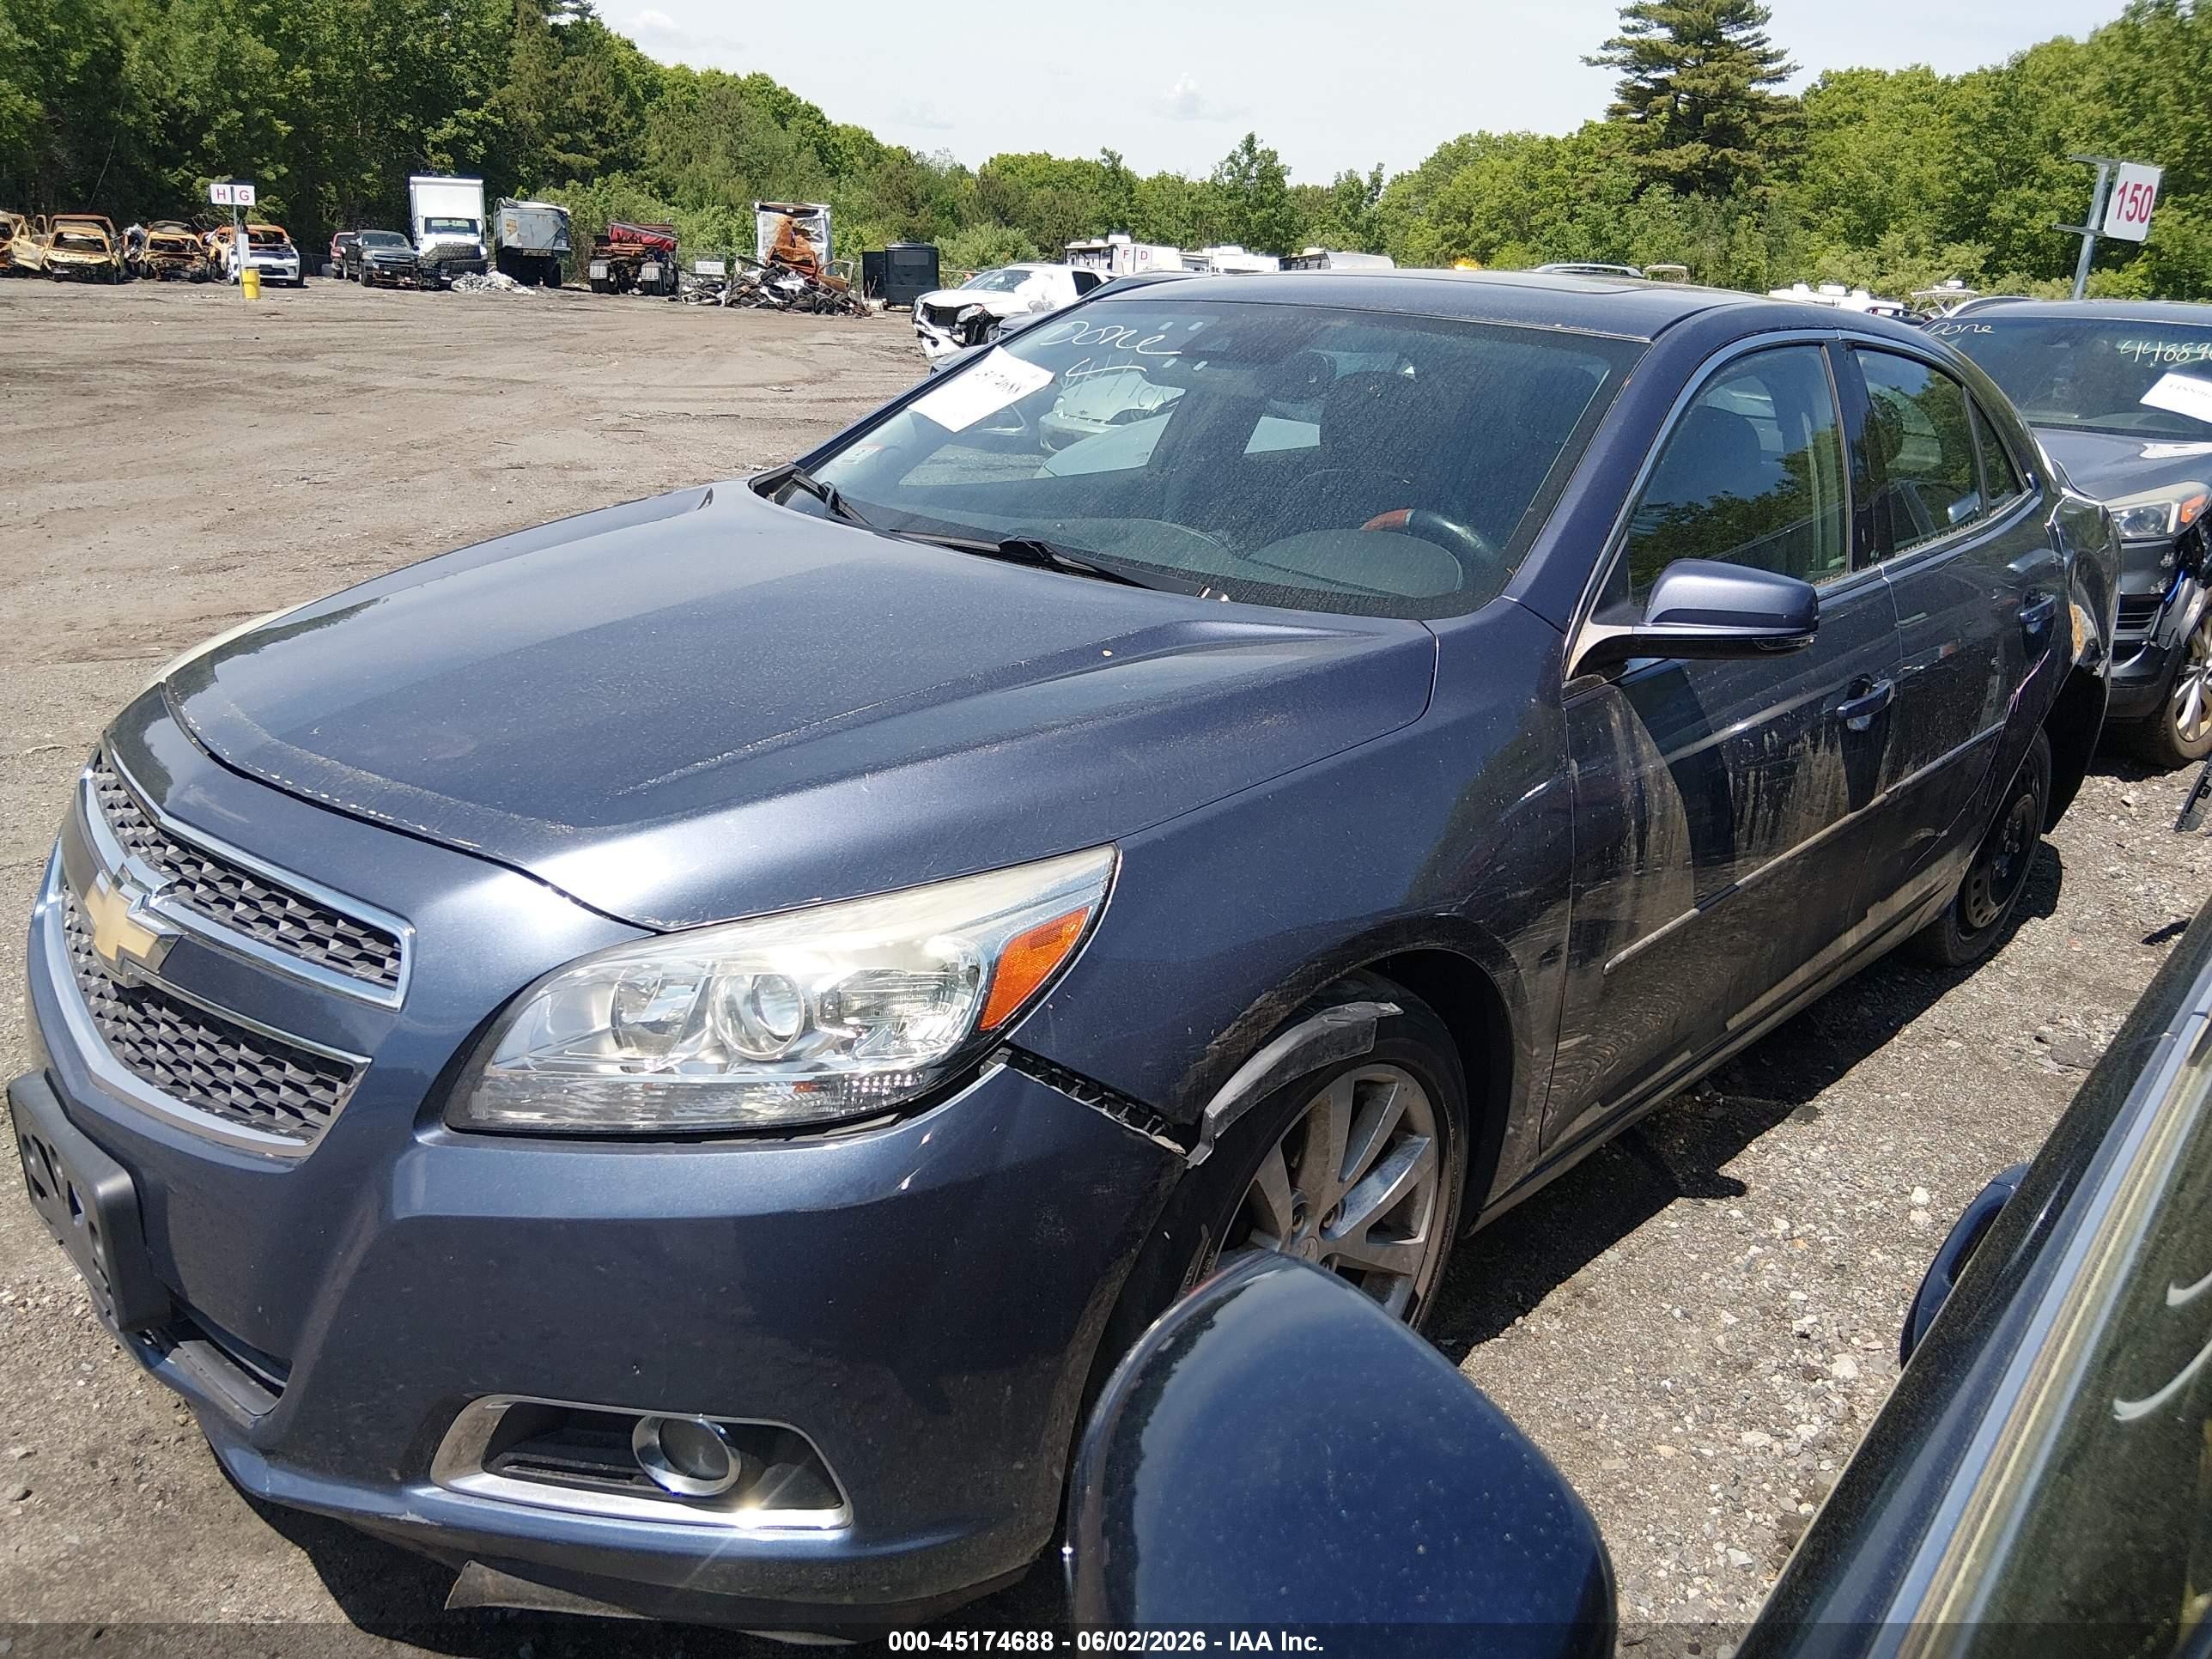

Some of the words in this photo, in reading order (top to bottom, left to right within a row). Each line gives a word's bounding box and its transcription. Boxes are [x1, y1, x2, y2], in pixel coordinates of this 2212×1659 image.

[216, 188, 227, 200] H
[239, 190, 250, 201] G
[2117, 180, 2154, 224] 150
[1123, 249, 1130, 259] F
[1140, 250, 1148, 260] D
[1926, 322, 1996, 336] Done
[1039, 320, 1182, 355] Done
